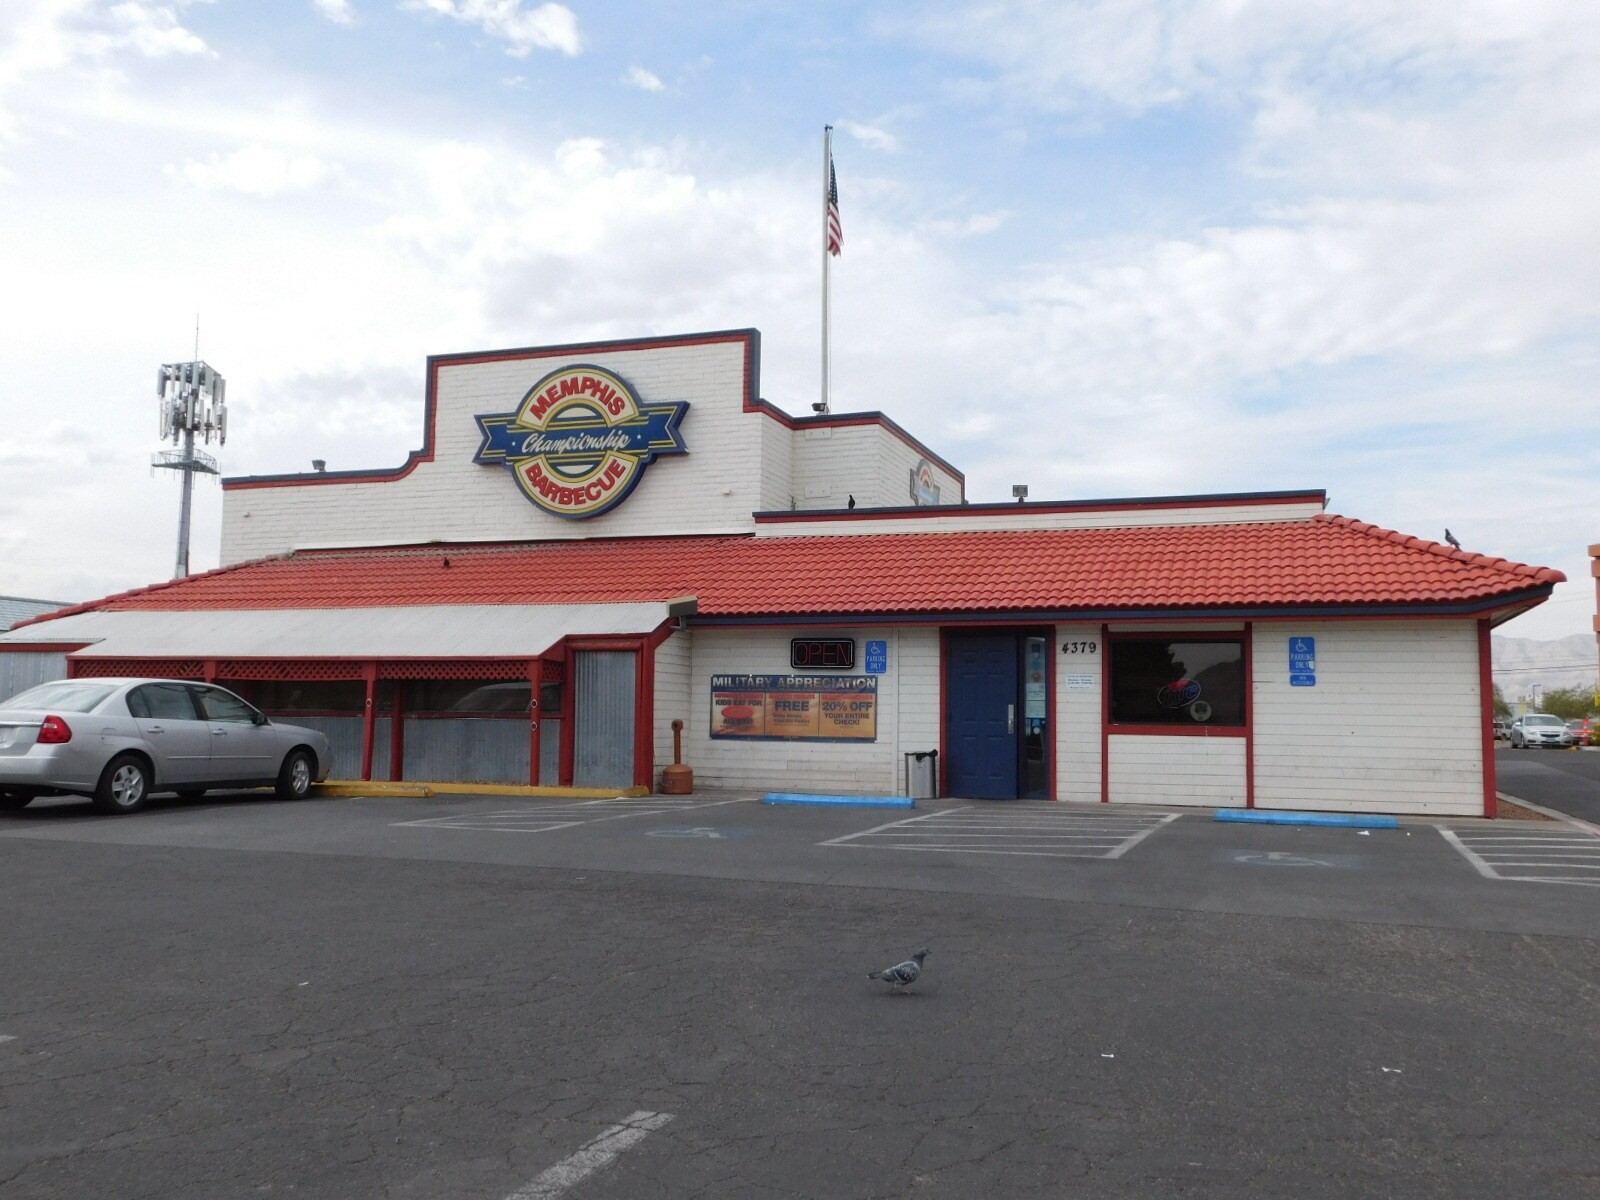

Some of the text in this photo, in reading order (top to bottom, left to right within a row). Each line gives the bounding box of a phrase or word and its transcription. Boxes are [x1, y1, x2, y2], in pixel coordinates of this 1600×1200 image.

[529, 376, 626, 421] MEMPHIS
[521, 429, 631, 454] Championship
[525, 459, 627, 506] BARBECUE
[794, 643, 851, 665] OPEN
[1062, 642, 1097, 654] 4379
[712, 677, 876, 689] MILITARY APPRECIATION
[775, 700, 809, 711] FREE
[822, 701, 873, 712] 20% OFF
